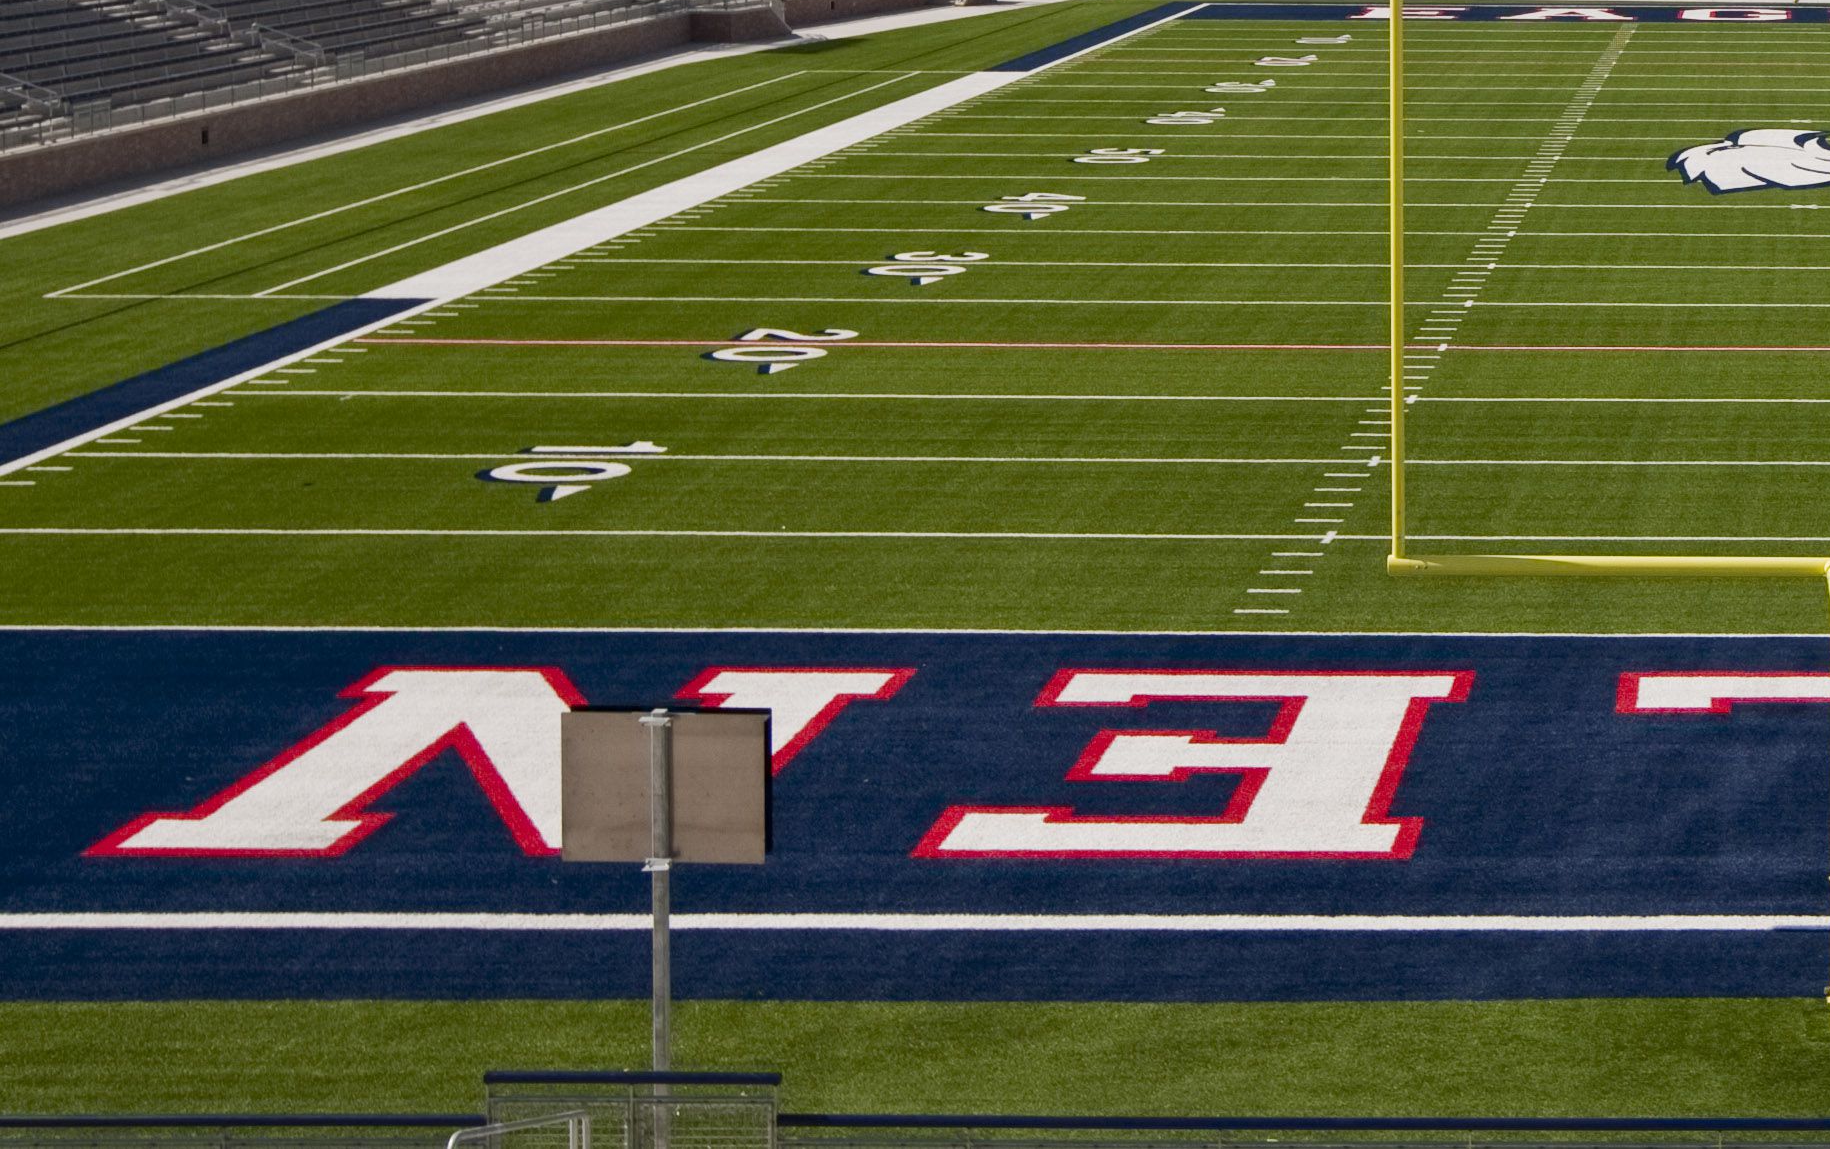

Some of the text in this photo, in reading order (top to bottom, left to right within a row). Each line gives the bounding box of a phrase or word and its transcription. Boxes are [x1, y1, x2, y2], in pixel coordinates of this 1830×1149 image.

[1205, 81, 1273, 92] 30
[1146, 110, 1225, 124] 40
[1074, 148, 1166, 163] 50
[983, 192, 1087, 213] 40
[868, 251, 989, 276] 30
[712, 328, 859, 361] 20
[490, 441, 668, 482] 10
